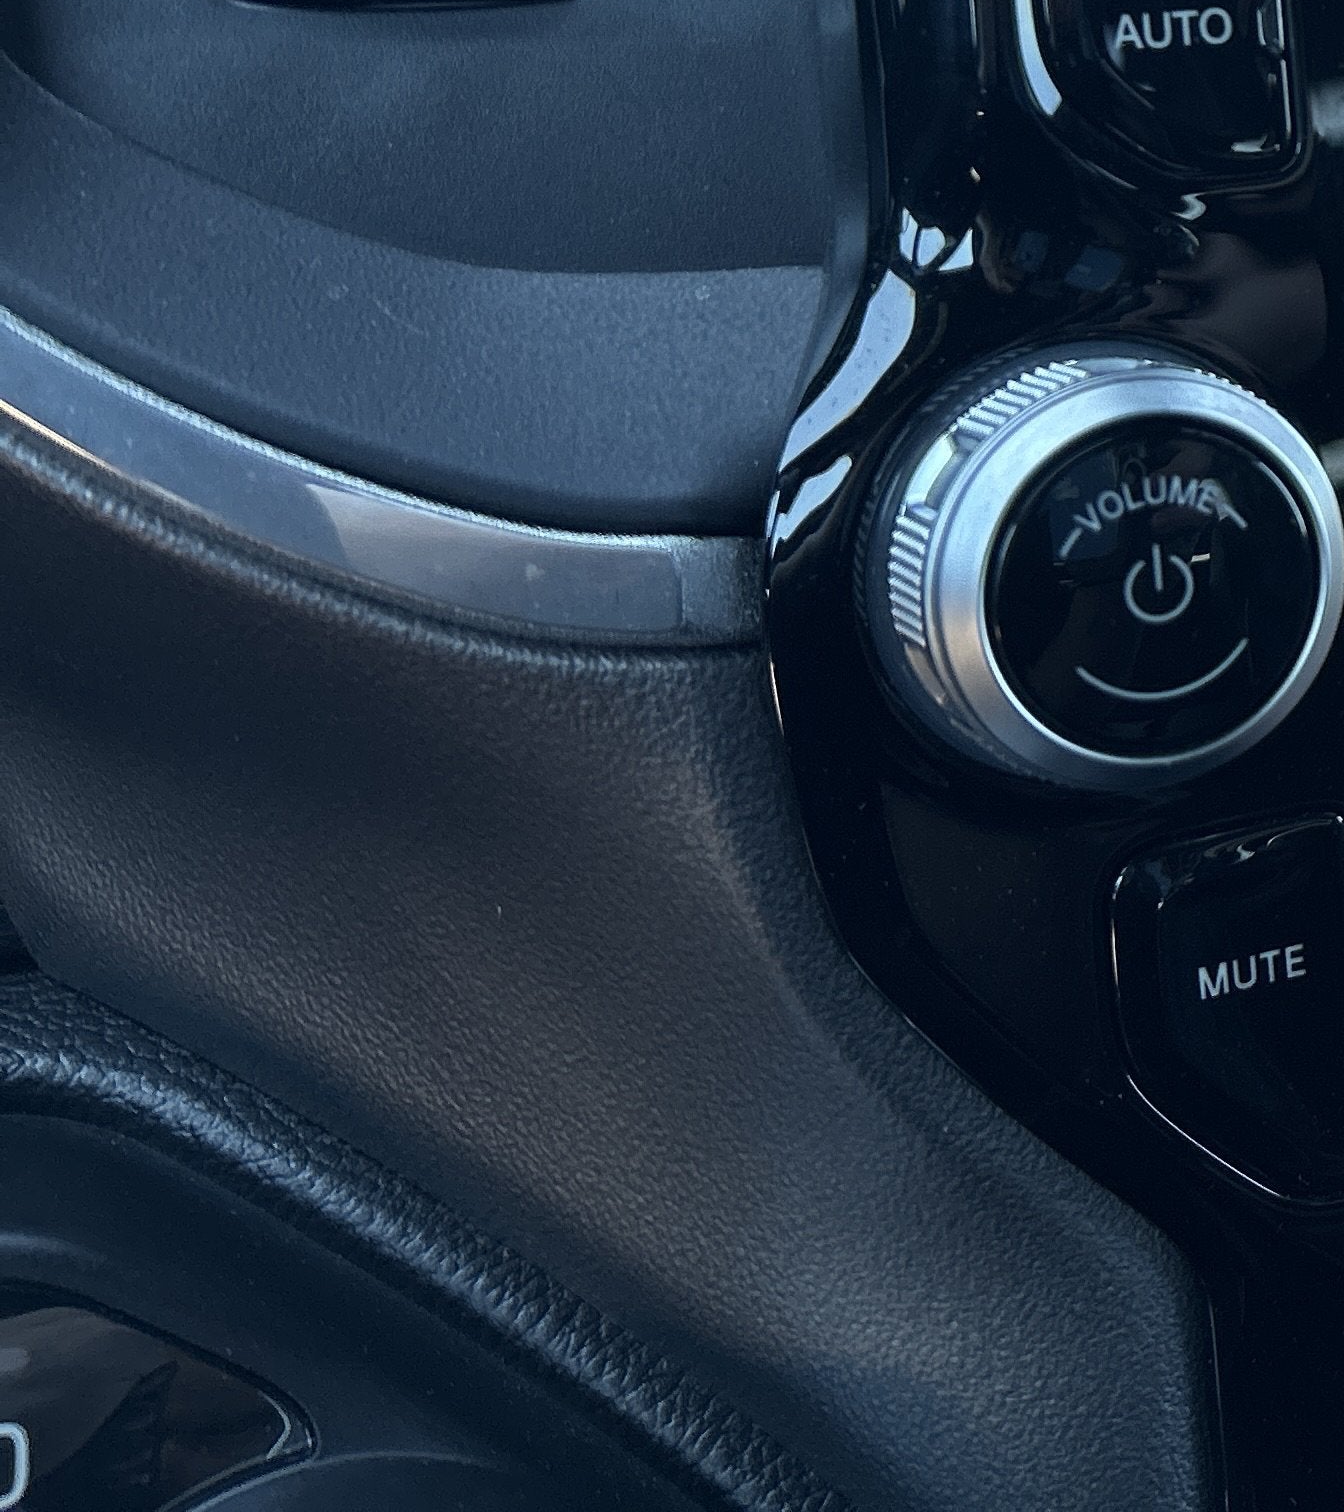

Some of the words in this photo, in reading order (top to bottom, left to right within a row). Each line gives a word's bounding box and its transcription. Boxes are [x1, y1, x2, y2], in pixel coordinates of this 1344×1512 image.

[1114, 5, 1234, 49] AUTO
[1073, 475, 1222, 532] VOLUME
[1198, 944, 1307, 1000] MUTE
